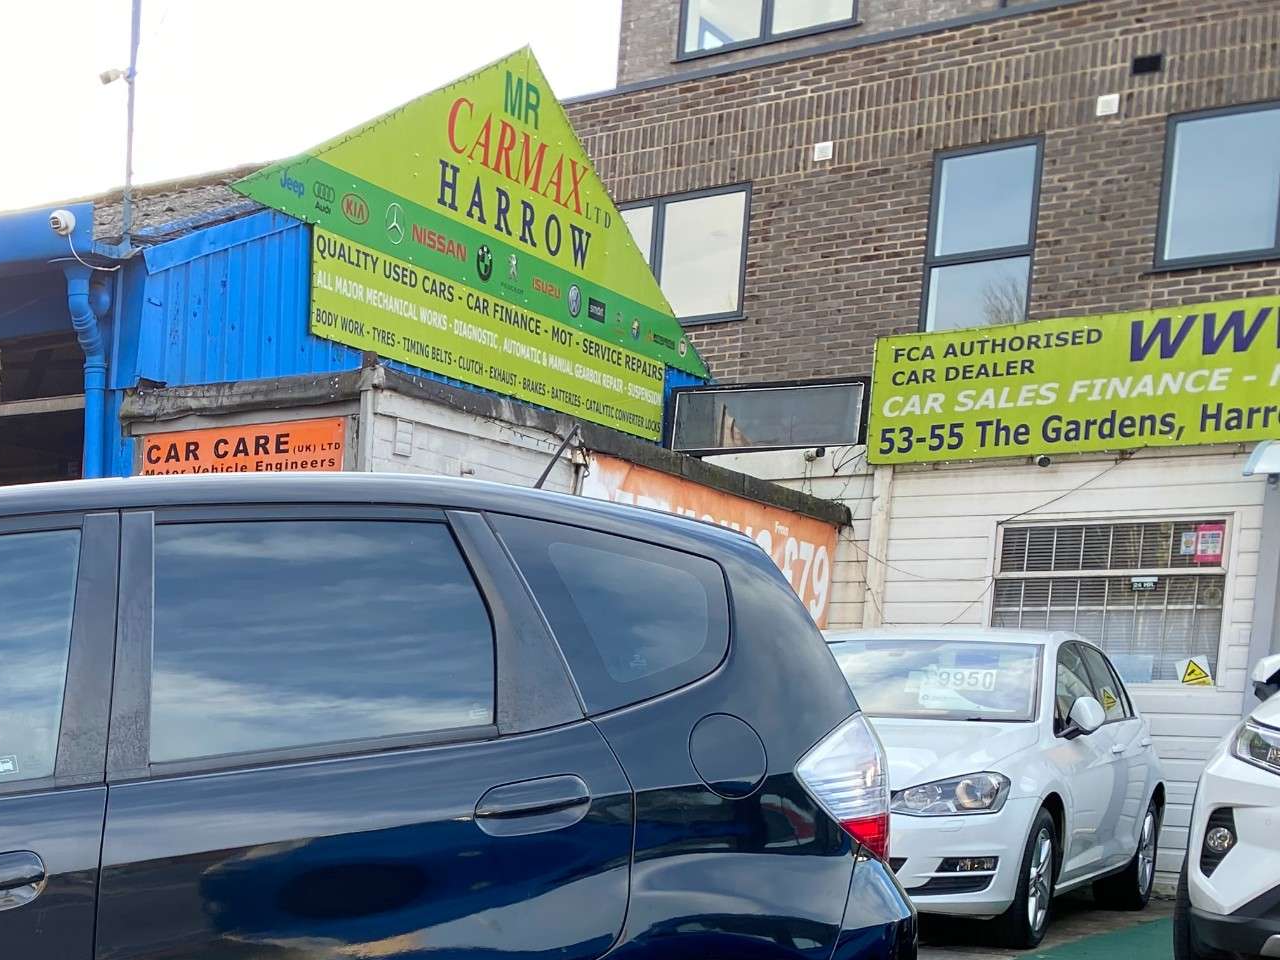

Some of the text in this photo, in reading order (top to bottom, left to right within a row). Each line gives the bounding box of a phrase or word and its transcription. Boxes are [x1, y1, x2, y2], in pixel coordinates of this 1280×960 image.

[503, 70, 540, 130] MR
[447, 97, 612, 229] CARMAX LTD
[280, 171, 305, 198] Jeep
[345, 202, 365, 221] KIA
[412, 223, 467, 262] NISSAN
[532, 276, 561, 299] ISUZU
[437, 159, 592, 271] HARROW
[316, 235, 379, 274] QUALITY
[383, 260, 418, 288] USED
[422, 275, 455, 302] CARS
[466, 293, 489, 316] CAR
[493, 303, 541, 335] FINANCE
[551, 325, 573, 347] MOT
[582, 337, 622, 366] SERVICE
[624, 354, 663, 381] REPAIRS
[317, 270, 333, 290] ALL
[335, 277, 365, 303] MAJOR
[366, 289, 418, 321] MECHANICAL
[420, 308, 448, 331] WORKS
[316, 308, 338, 330] BODY
[340, 316, 365, 337] WORK
[372, 327, 395, 347] TYRES
[402, 336, 429, 358] TIMING
[431, 347, 452, 366] BELTS
[458, 355, 483, 375] CLUTCH
[489, 366, 517, 387] EXHAUST
[522, 377, 546, 396] BRAKES
[551, 385, 581, 408] BATTERIES
[892, 359, 1035, 386] CAR DEALER
[893, 345, 935, 363] FCA
[943, 328, 1103, 359] AUTHORISED
[882, 392, 946, 418] CAR
[954, 382, 1060, 412] SALES
[1068, 367, 1233, 403] FINANCE
[146, 433, 341, 465] CAR CARE (UK) LTD
[879, 402, 1280, 455] 53-55 The Gardens, Harr
[192, 462, 248, 474] Vehicle
[255, 456, 336, 473] Engineers
